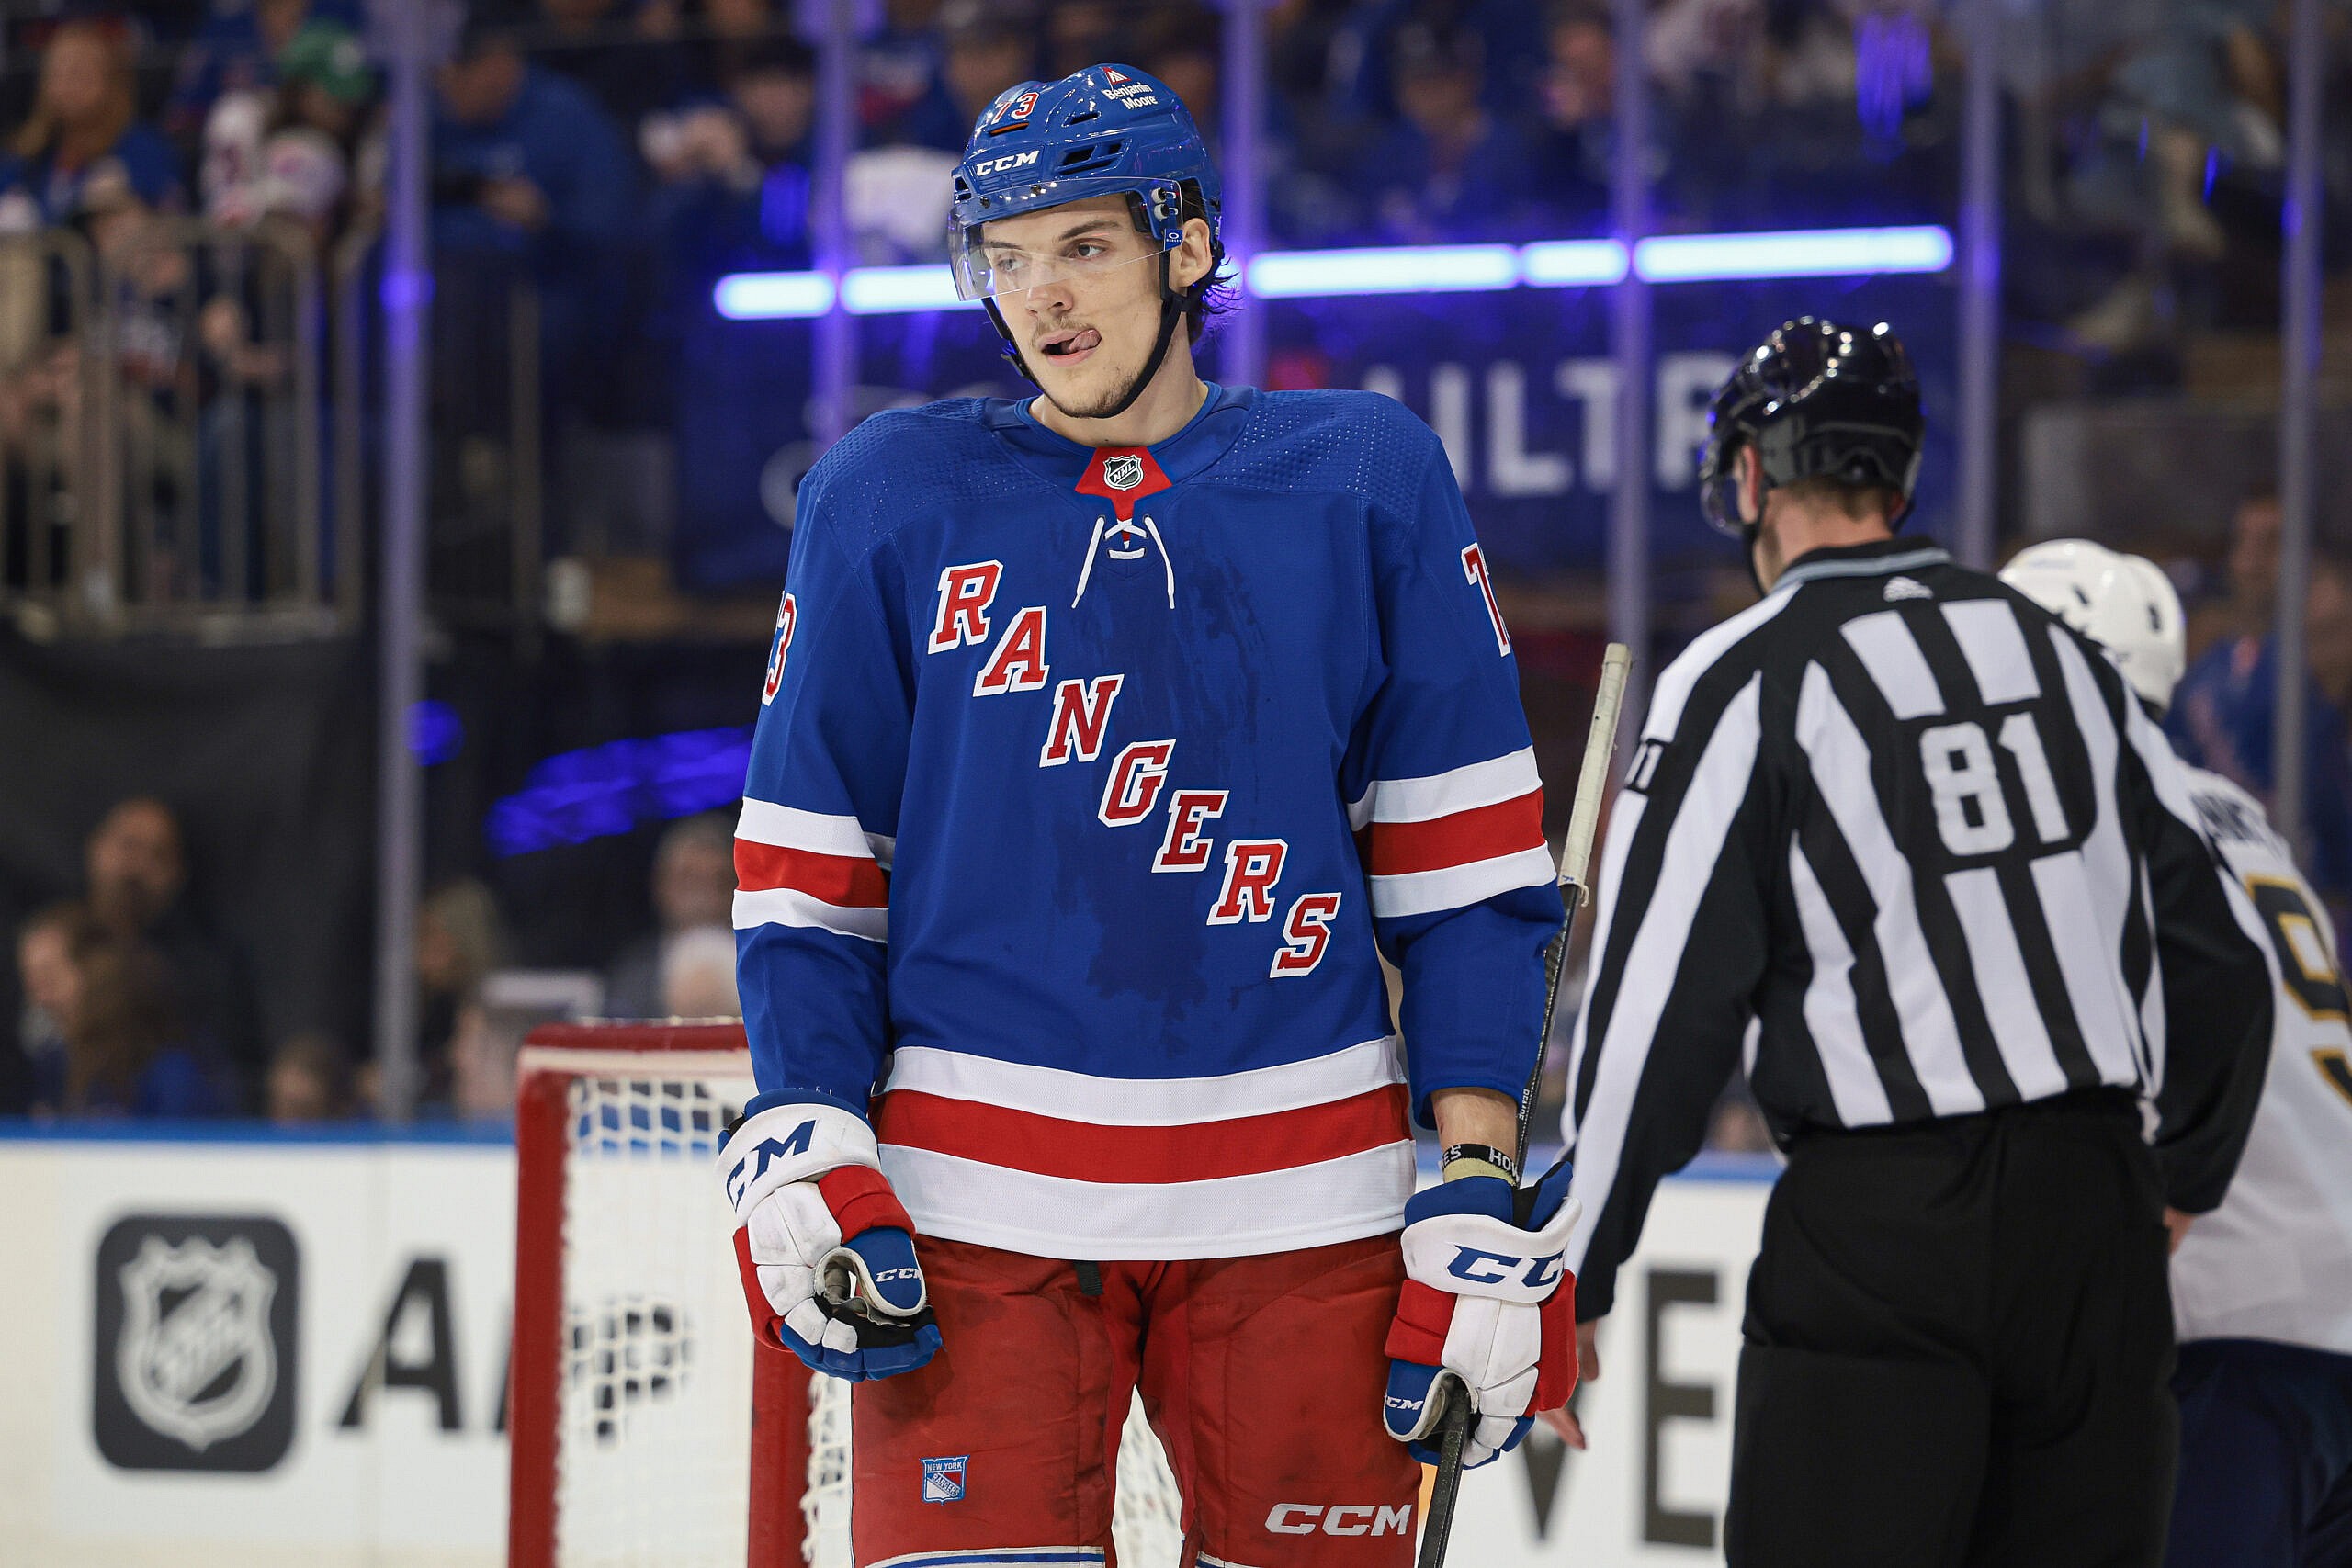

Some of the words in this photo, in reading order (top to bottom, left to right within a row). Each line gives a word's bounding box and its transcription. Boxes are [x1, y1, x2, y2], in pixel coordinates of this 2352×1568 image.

[1102, 82, 1153, 100] Benjamin
[1122, 96, 1158, 110] Moore
[991, 92, 1039, 125] 73
[977, 150, 1040, 176] CCM
[1113, 463, 1135, 482] NHL
[1461, 542, 1510, 658] 7
[762, 590, 797, 706] 3
[928, 559, 1341, 979] RANGERS
[1920, 712, 2070, 855] 81
[1439, 1145, 1462, 1168] ES
[1385, 1395, 1424, 1411] CM
[927, 1463, 943, 1472] NEW
[944, 1461, 963, 1470] YORK
[932, 1473, 960, 1496] RANGERS
[1264, 1503, 1412, 1537] CCM
